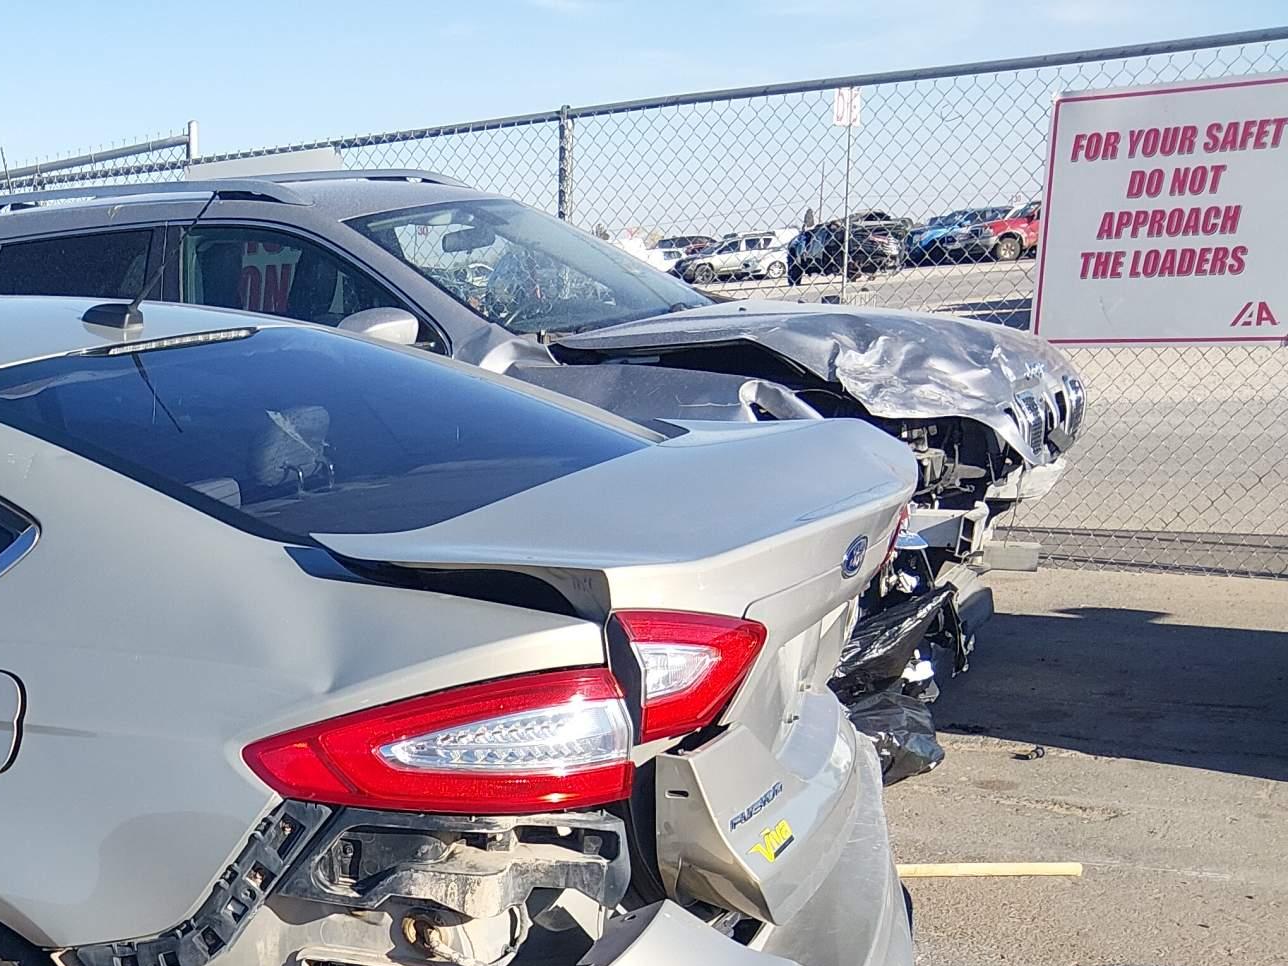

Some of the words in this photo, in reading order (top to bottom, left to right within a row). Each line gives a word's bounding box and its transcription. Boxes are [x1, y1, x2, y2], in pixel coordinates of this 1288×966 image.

[1071, 131, 1121, 162] FOR
[1128, 125, 1198, 158] YOUR
[1127, 168, 1164, 198] DO
[1169, 164, 1227, 196] NOT
[1096, 205, 1242, 240] APPROACH
[1079, 250, 1126, 279] THE
[1129, 246, 1248, 278] LOADERS
